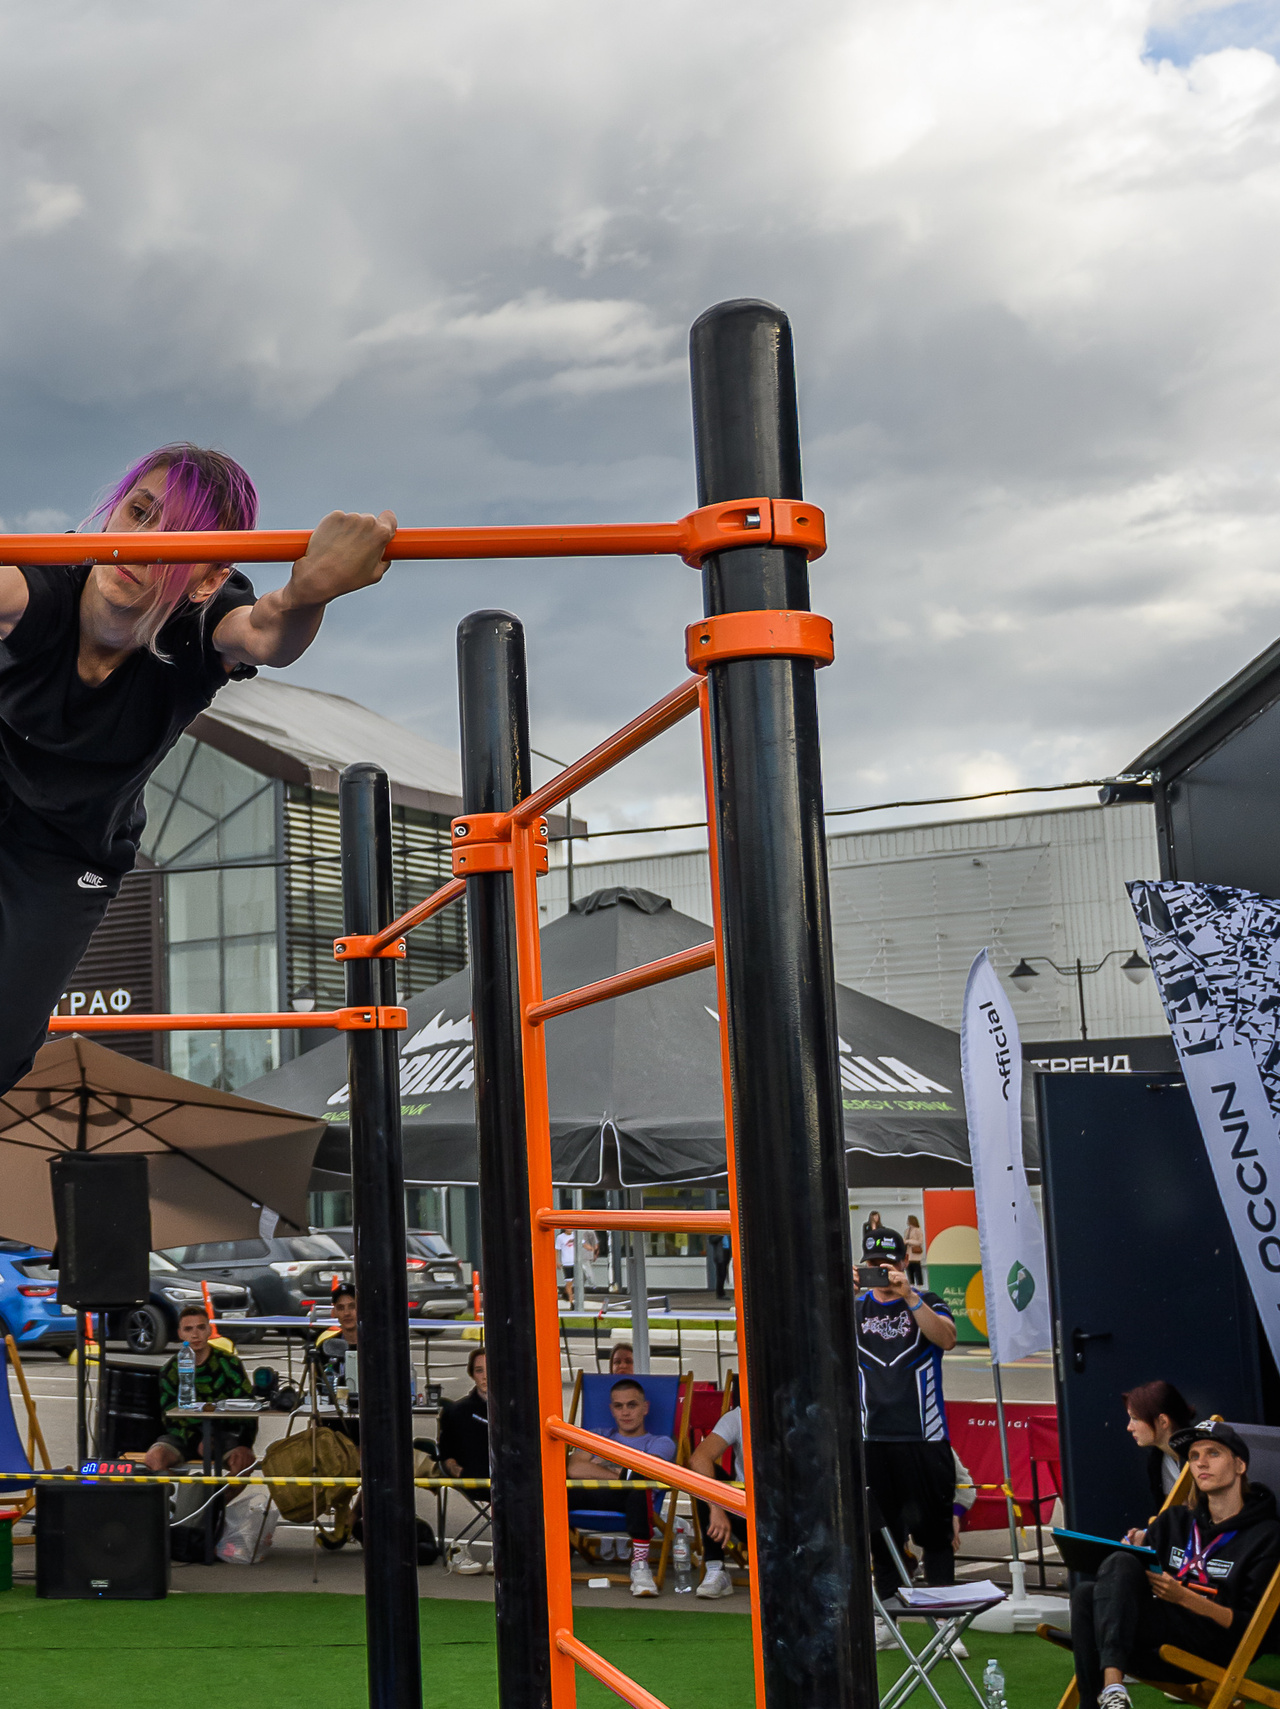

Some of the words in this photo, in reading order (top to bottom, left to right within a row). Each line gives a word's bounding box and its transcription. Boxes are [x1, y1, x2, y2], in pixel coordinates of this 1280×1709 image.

[83, 871, 103, 886] NIKE
[943, 1287, 965, 1296] ALL
[951, 1308, 984, 1318] ARTY
